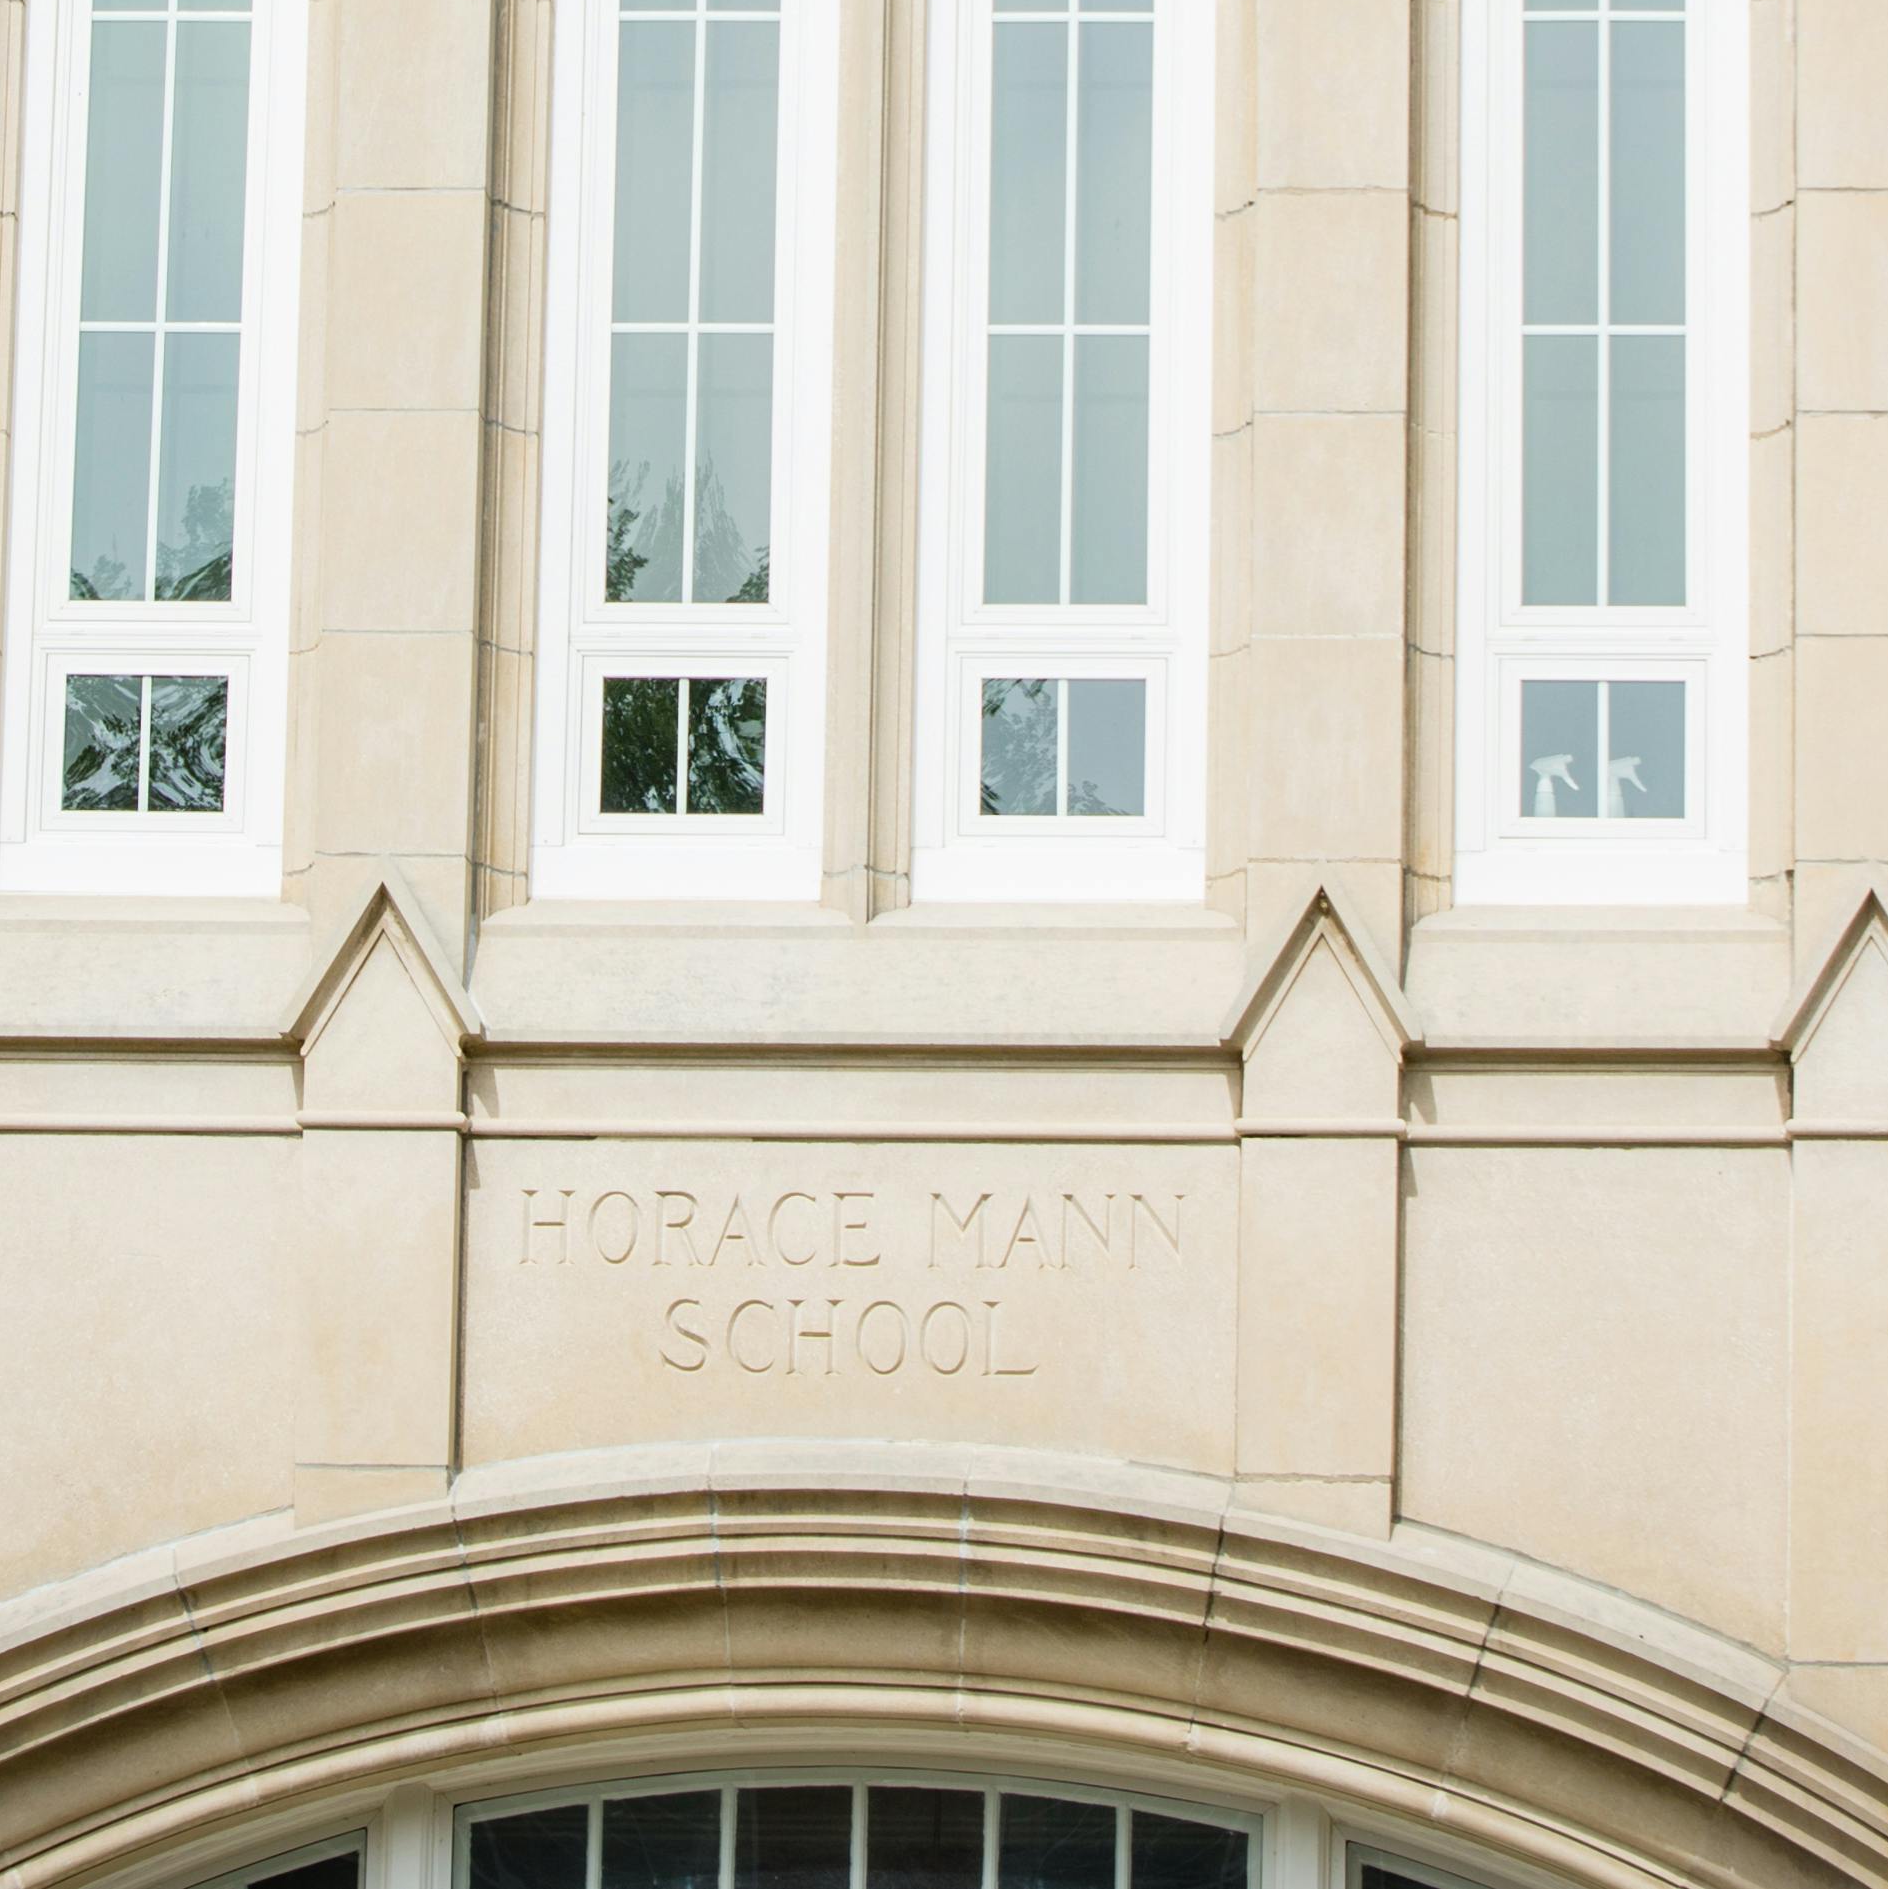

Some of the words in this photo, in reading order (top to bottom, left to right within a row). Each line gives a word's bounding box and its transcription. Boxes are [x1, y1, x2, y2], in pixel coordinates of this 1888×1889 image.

[520, 1189, 881, 1267] HORACE
[928, 1192, 1187, 1270] MANN
[659, 1298, 1039, 1377] SCHOOL
